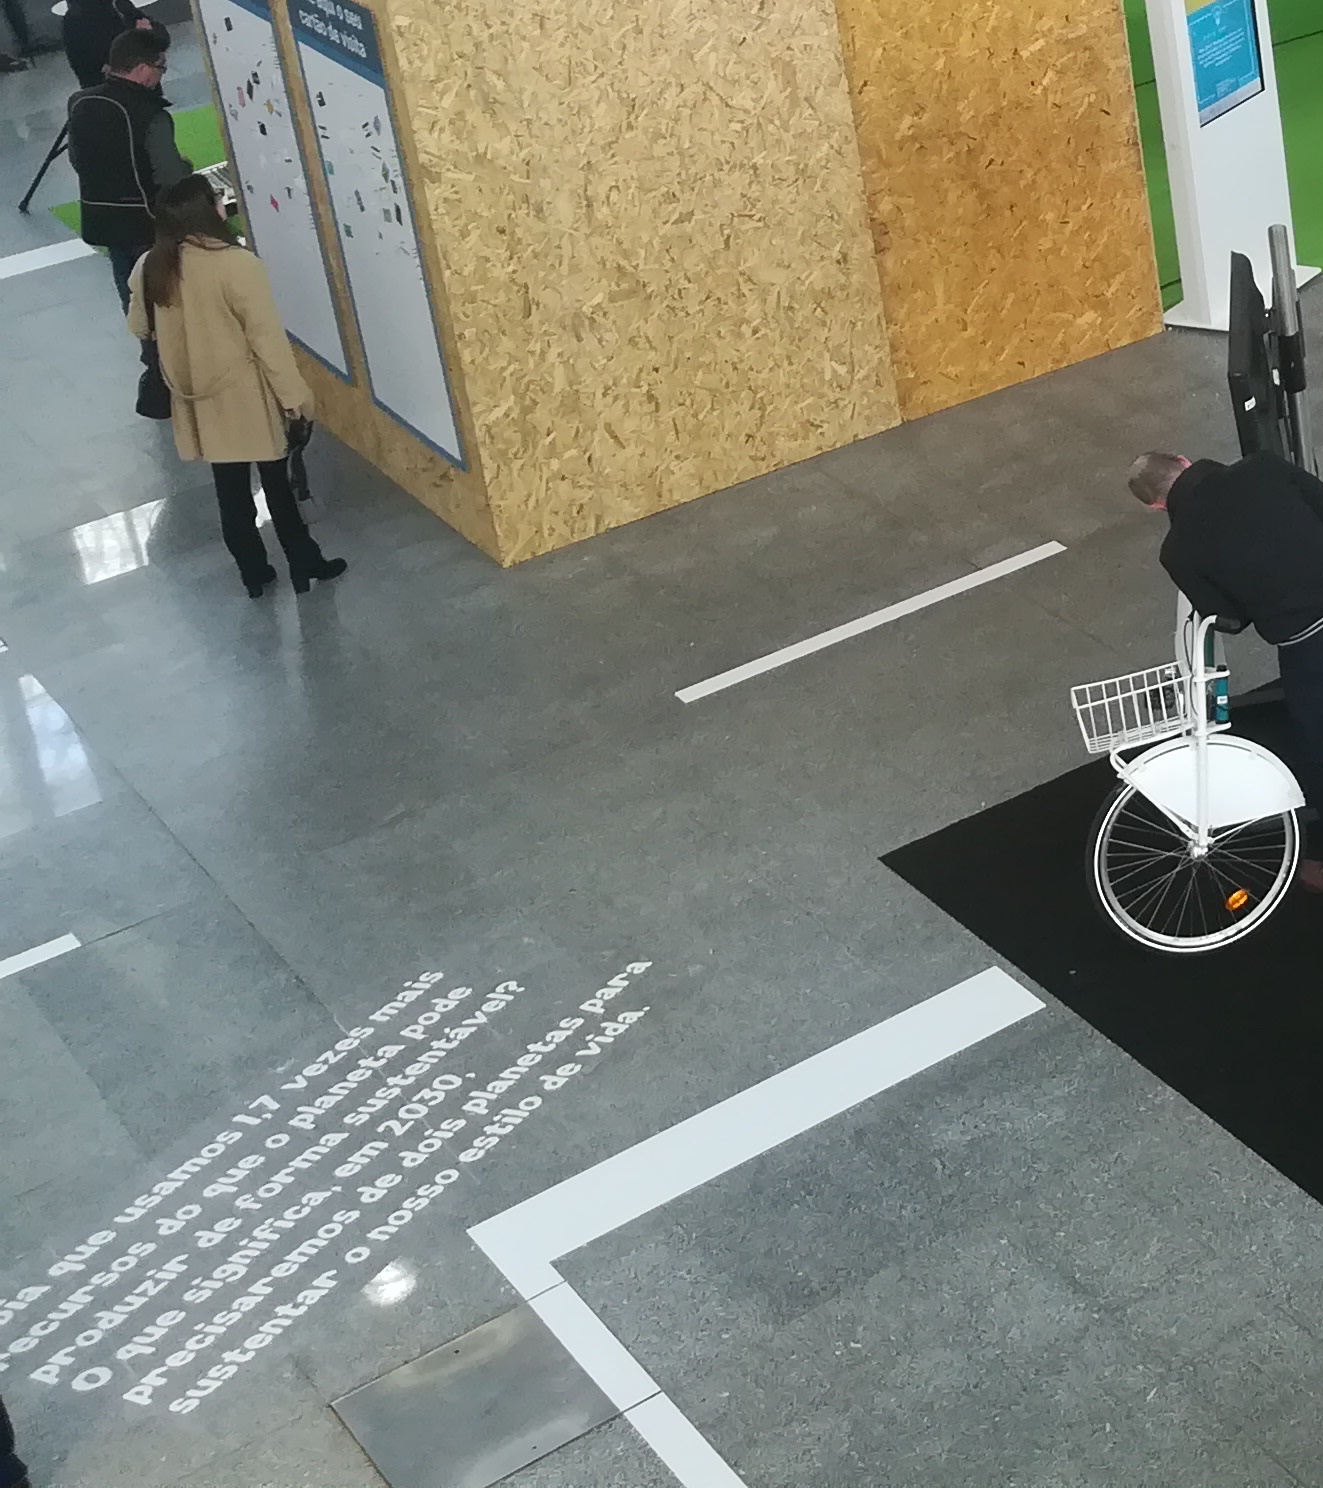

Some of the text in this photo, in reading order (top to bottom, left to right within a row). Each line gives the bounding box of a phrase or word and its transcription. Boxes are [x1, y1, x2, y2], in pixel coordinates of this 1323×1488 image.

[29, 979, 526, 1385] produzir de forma sustentável?
[48, 971, 445, 1277] que usamos 1,7 vezes mais
[70, 1365, 114, 1392] O
[116, 1309, 187, 1361] que
[182, 1185, 343, 1304] significa,
[334, 1140, 390, 1178] em
[122, 961, 653, 1406] precisaremos de dois planetas para
[155, 1203, 202, 1237] do
[202, 1153, 267, 1198] que
[265, 1132, 291, 1149] o
[287, 1044, 407, 1130] planeta
[399, 986, 473, 1040] pode
[168, 1269, 339, 1415] sustentar
[344, 1245, 371, 1264] o
[365, 1168, 461, 1242] nosso
[457, 1095, 543, 1163] estilo
[538, 1062, 583, 1091] de
